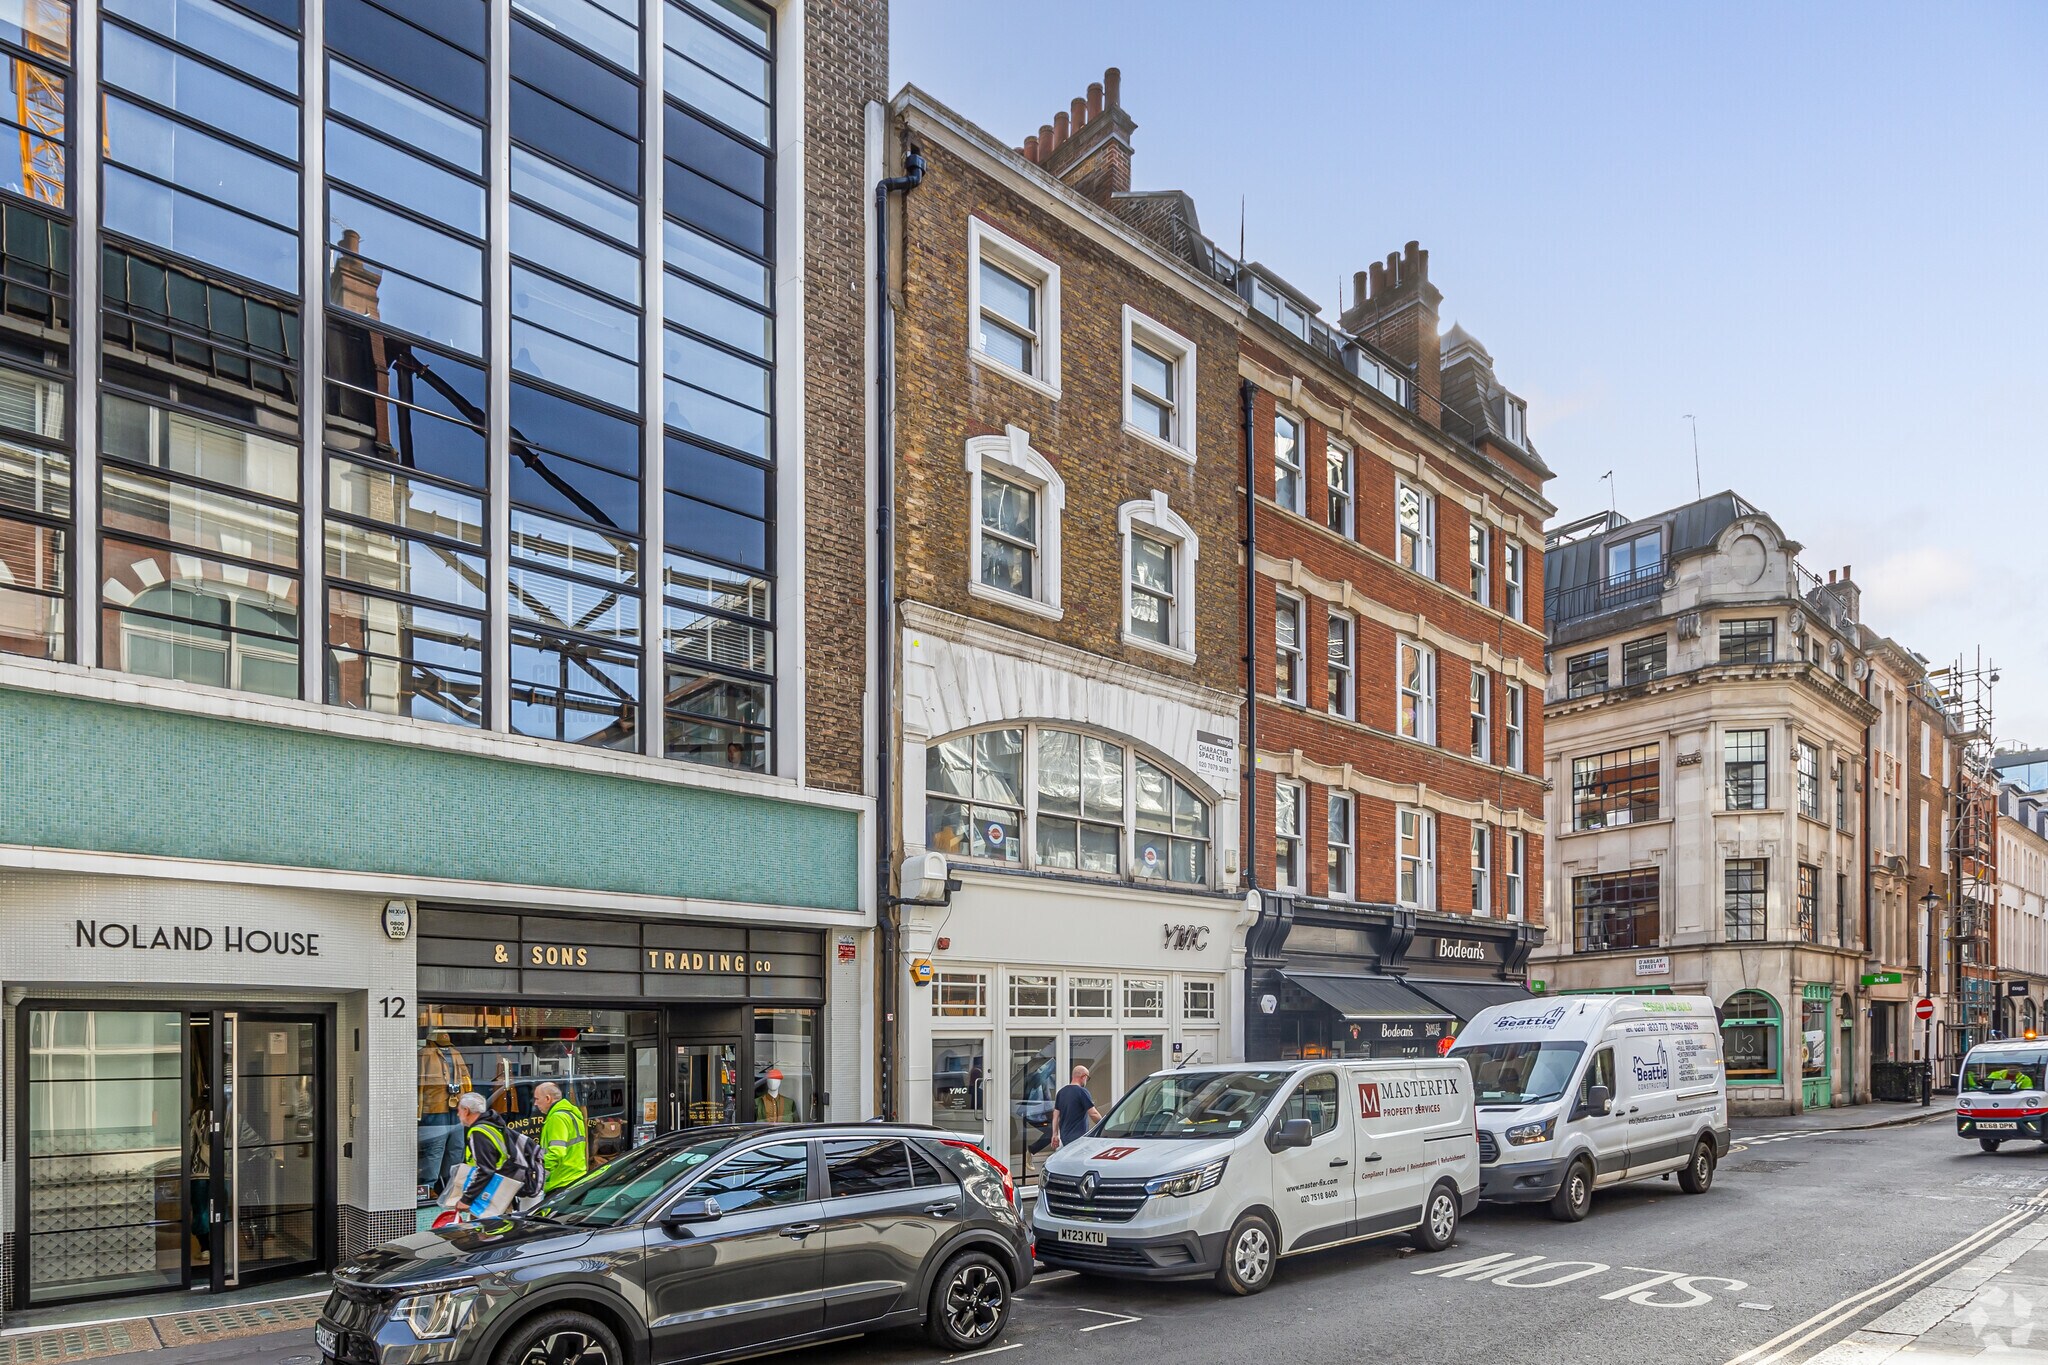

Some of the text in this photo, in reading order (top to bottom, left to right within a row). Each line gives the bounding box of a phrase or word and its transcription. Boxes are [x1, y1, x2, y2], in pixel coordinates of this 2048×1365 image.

[1199, 745, 1228, 757] CHARACTER
[1199, 751, 1214, 760] SPACE
[76, 920, 320, 957] NOLAND HOUSE
[1164, 923, 1210, 952] YMC
[1440, 938, 1484, 960] Bodean's
[494, 944, 771, 972] & SONS TRADING CO
[379, 996, 406, 1018] 12
[1643, 1002, 1692, 1011] DESIGN AND BUILD
[1381, 1023, 1414, 1037] Bodean's
[1498, 1018, 1556, 1028] Beattie
[1637, 1066, 1667, 1081] Beattie
[949, 1087, 968, 1095] YMC
[1381, 1079, 1459, 1100] MASTERFIX
[1638, 1082, 1668, 1090] CONSTRUCTION
[1362, 1088, 1379, 1114] M
[1383, 1104, 1440, 1117] PROPERTY SERVICES
[507, 1118, 529, 1130] ONS
[1361, 1154, 1466, 1180] Compliance Reactive Reinstatement Refurbishment
[1286, 1178, 1338, 1192] www.master-fix.com
[1301, 1190, 1338, 1203] 020 7518 8600
[1062, 1229, 1103, 1243] MT23 KTU
[1411, 1252, 1748, 1307] SLOW
